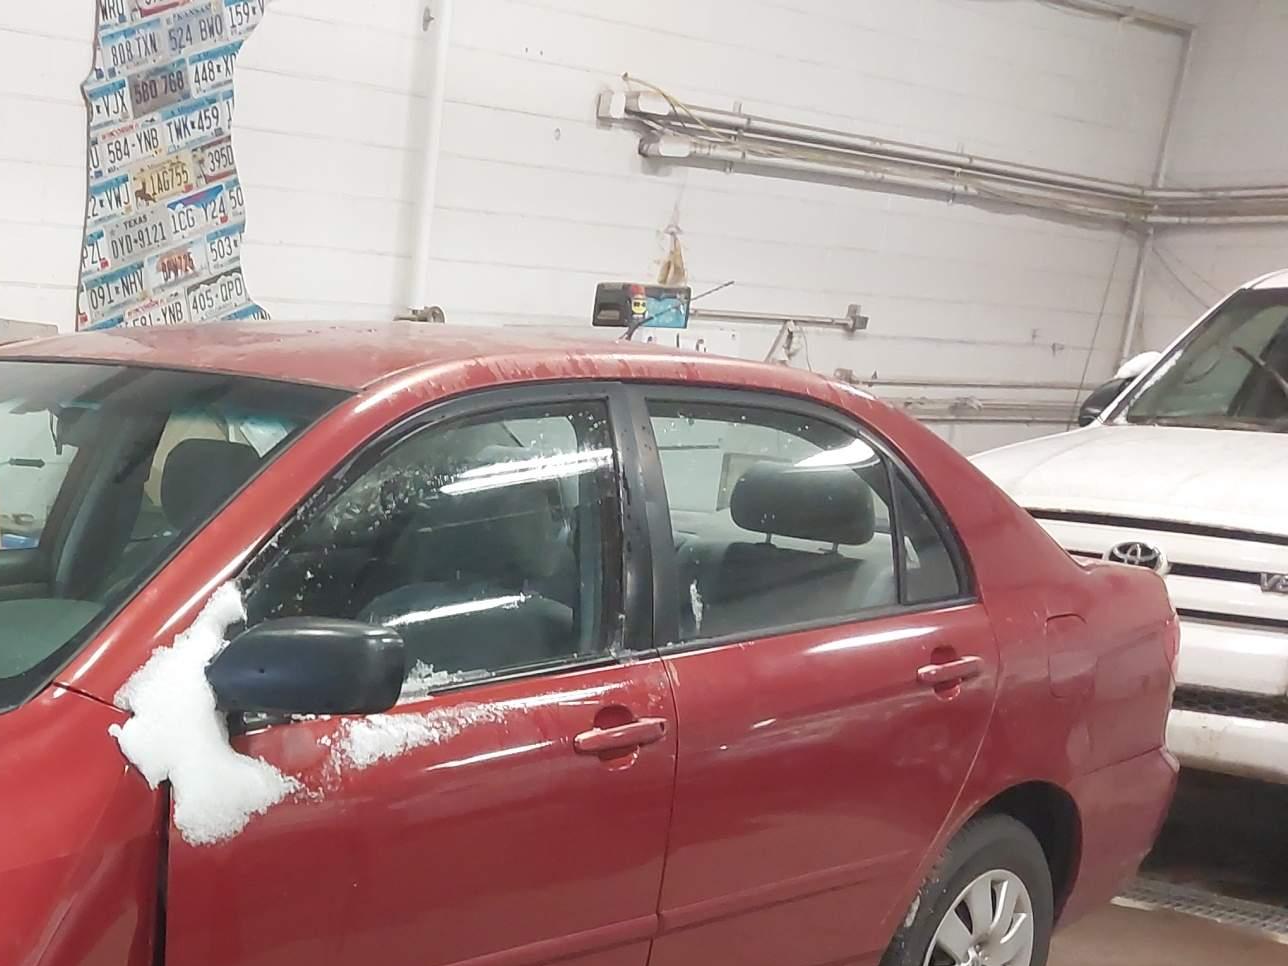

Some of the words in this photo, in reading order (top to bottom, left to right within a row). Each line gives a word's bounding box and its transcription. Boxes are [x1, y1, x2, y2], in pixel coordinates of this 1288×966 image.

[111, 40, 134, 66] 808
[136, 32, 158, 58] TXN
[168, 24, 193, 51] 524
[160, 70, 185, 94] 768
[194, 60, 215, 86] 448
[102, 89, 128, 117] VJX
[166, 114, 191, 143] TWK
[198, 105, 219, 131] 459
[124, 214, 148, 230] TEXAS
[202, 196, 226, 222] Y24
[138, 222, 166, 248] 9121
[210, 236, 233, 262] 503
[121, 269, 144, 298] NHV
